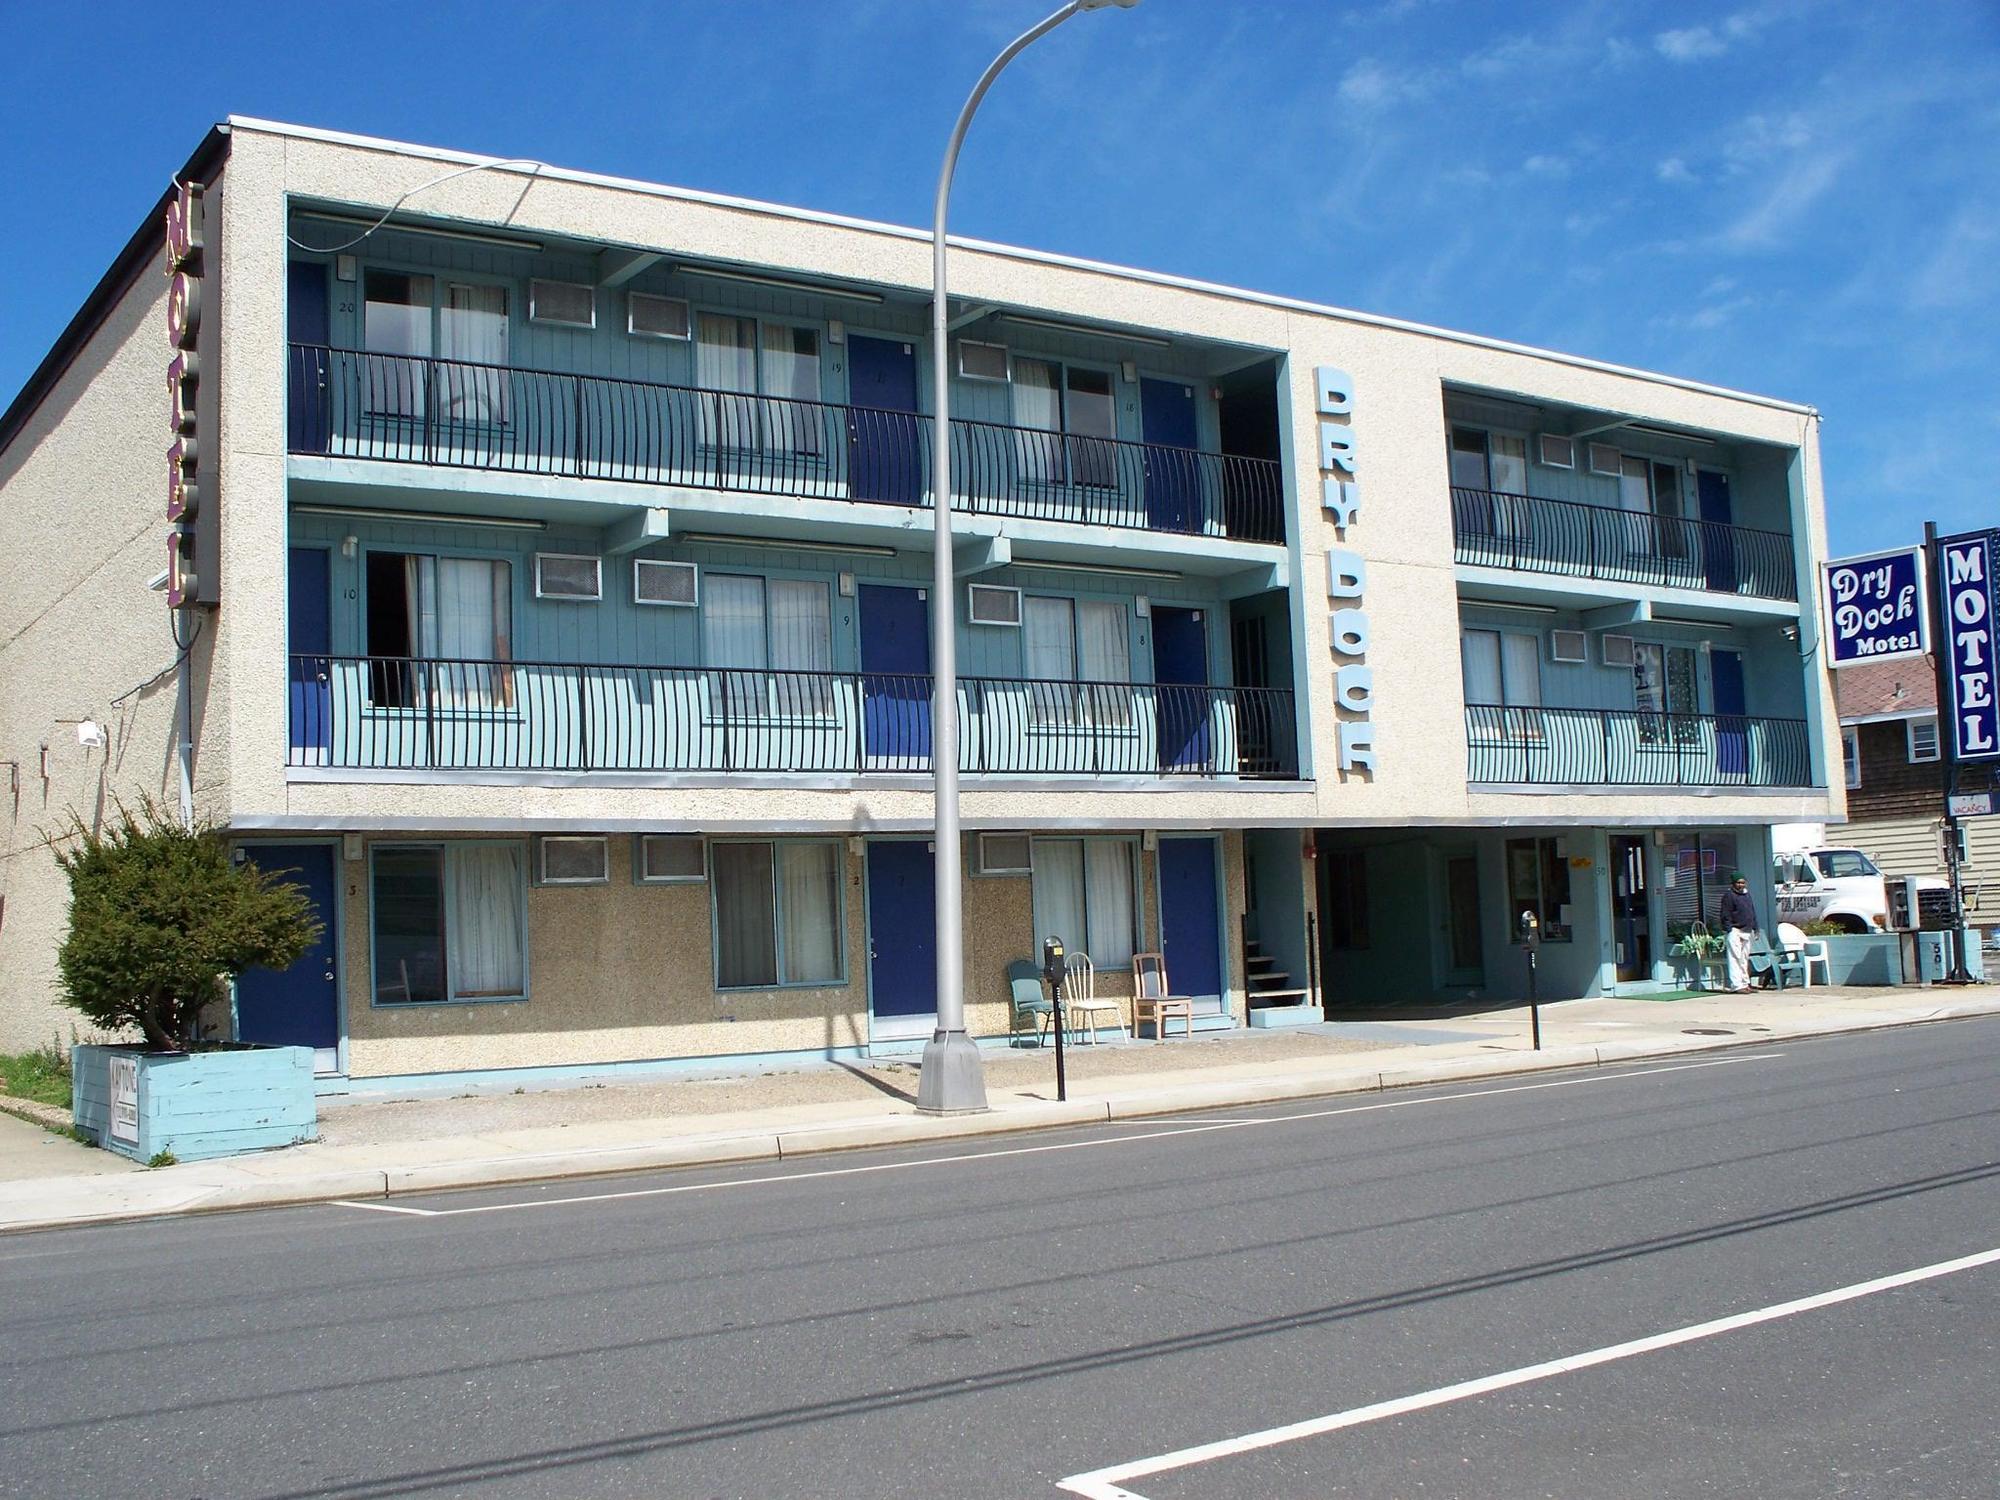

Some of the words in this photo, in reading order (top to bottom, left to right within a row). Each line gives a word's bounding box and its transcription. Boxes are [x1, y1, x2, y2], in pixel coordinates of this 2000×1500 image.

[339, 302, 354, 313] 20
[832, 362, 842, 374] 19
[166, 182, 200, 609] MOTEL
[1314, 366, 1359, 530] DRY
[1831, 564, 1893, 604] Dry
[343, 588, 356, 600] 10
[843, 615, 850, 626] 9
[1835, 585, 1916, 640] Dock
[1139, 635, 1145, 645] 8
[1856, 631, 1920, 656] Motel
[1949, 546, 1993, 752] MOTEL
[1327, 549, 1375, 771] DOCK
[1952, 804, 1986, 815] VACANCY
[853, 875, 860, 886] 2
